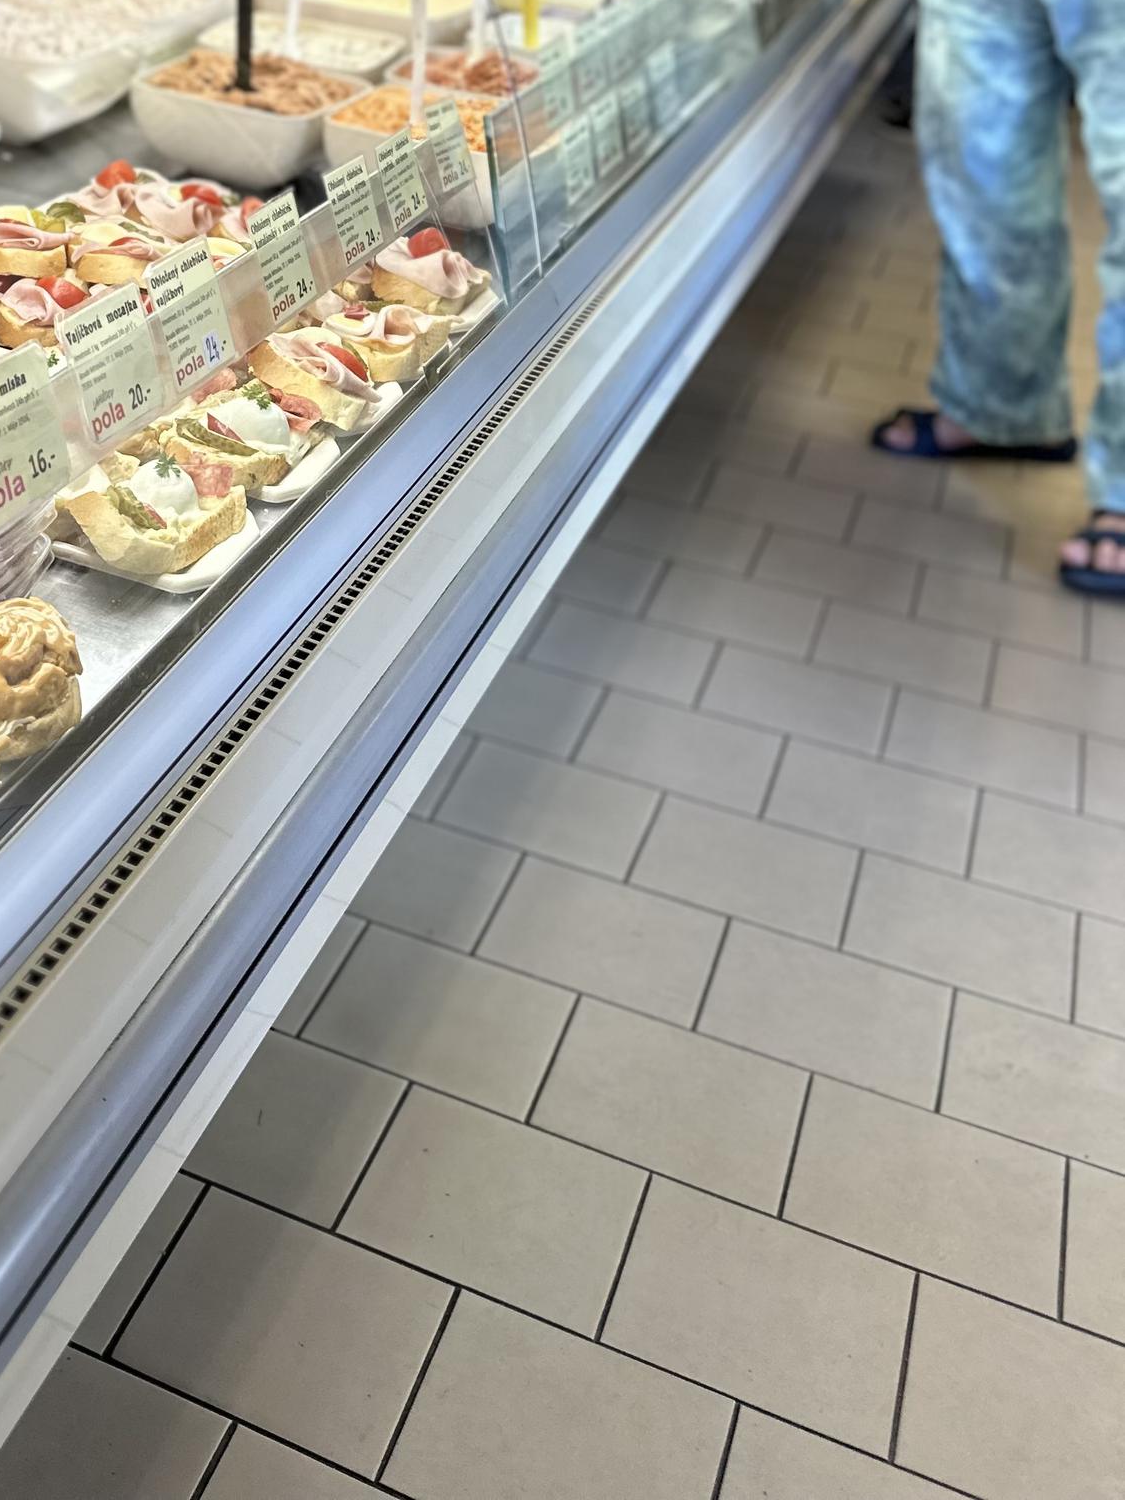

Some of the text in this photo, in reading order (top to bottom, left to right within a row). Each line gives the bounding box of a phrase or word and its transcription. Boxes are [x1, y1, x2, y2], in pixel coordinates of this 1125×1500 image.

[395, 205, 412, 229] pola
[346, 241, 366, 264] pola
[272, 293, 296, 321] pola
[65, 314, 103, 346] Vajíčková
[0, 373, 27, 397] miska
[175, 355, 205, 386] pola
[91, 383, 152, 441] pola 20.-
[28, 448, 56, 479] 16.-
